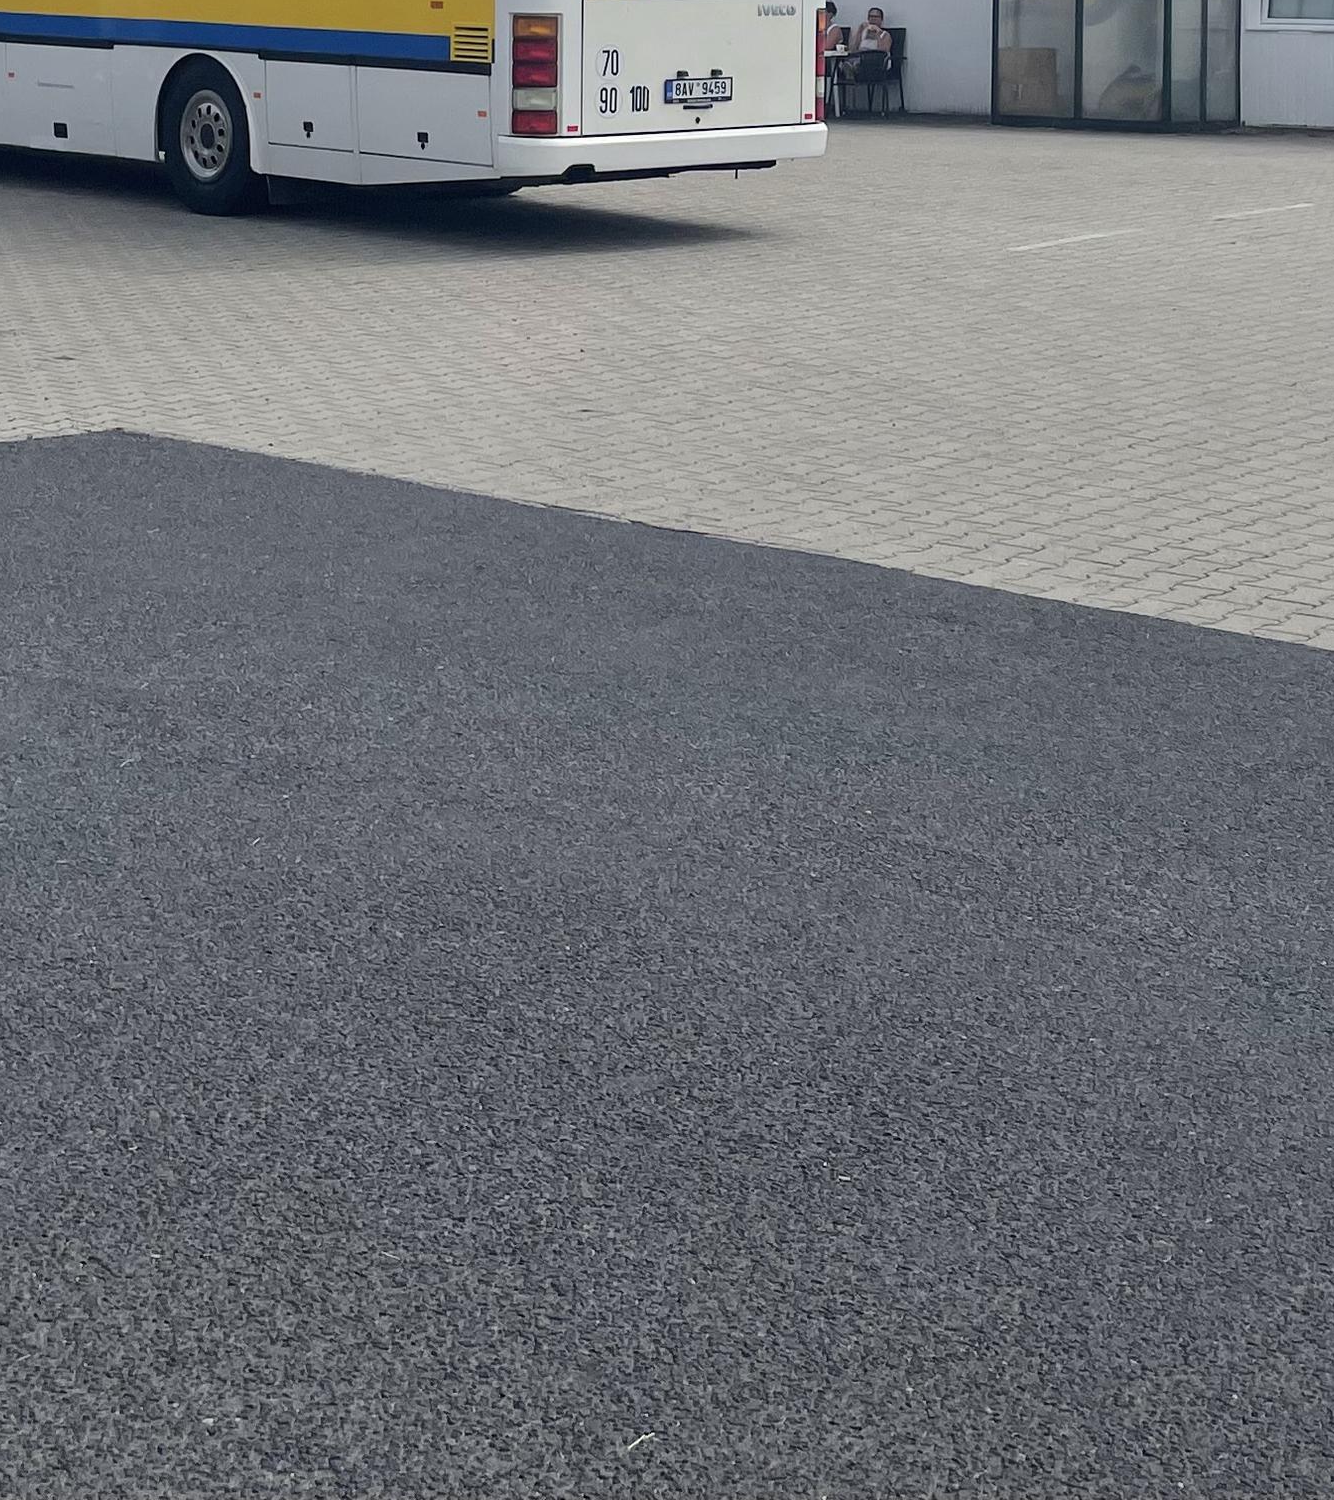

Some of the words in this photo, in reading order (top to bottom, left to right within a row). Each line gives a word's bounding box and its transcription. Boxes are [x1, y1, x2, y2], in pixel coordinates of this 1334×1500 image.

[757, 4, 797, 17] IVECO
[602, 49, 619, 77] 70
[599, 87, 618, 114] 90
[630, 85, 650, 113] 100
[675, 82, 694, 96] 8AV
[702, 81, 727, 95] 9459
